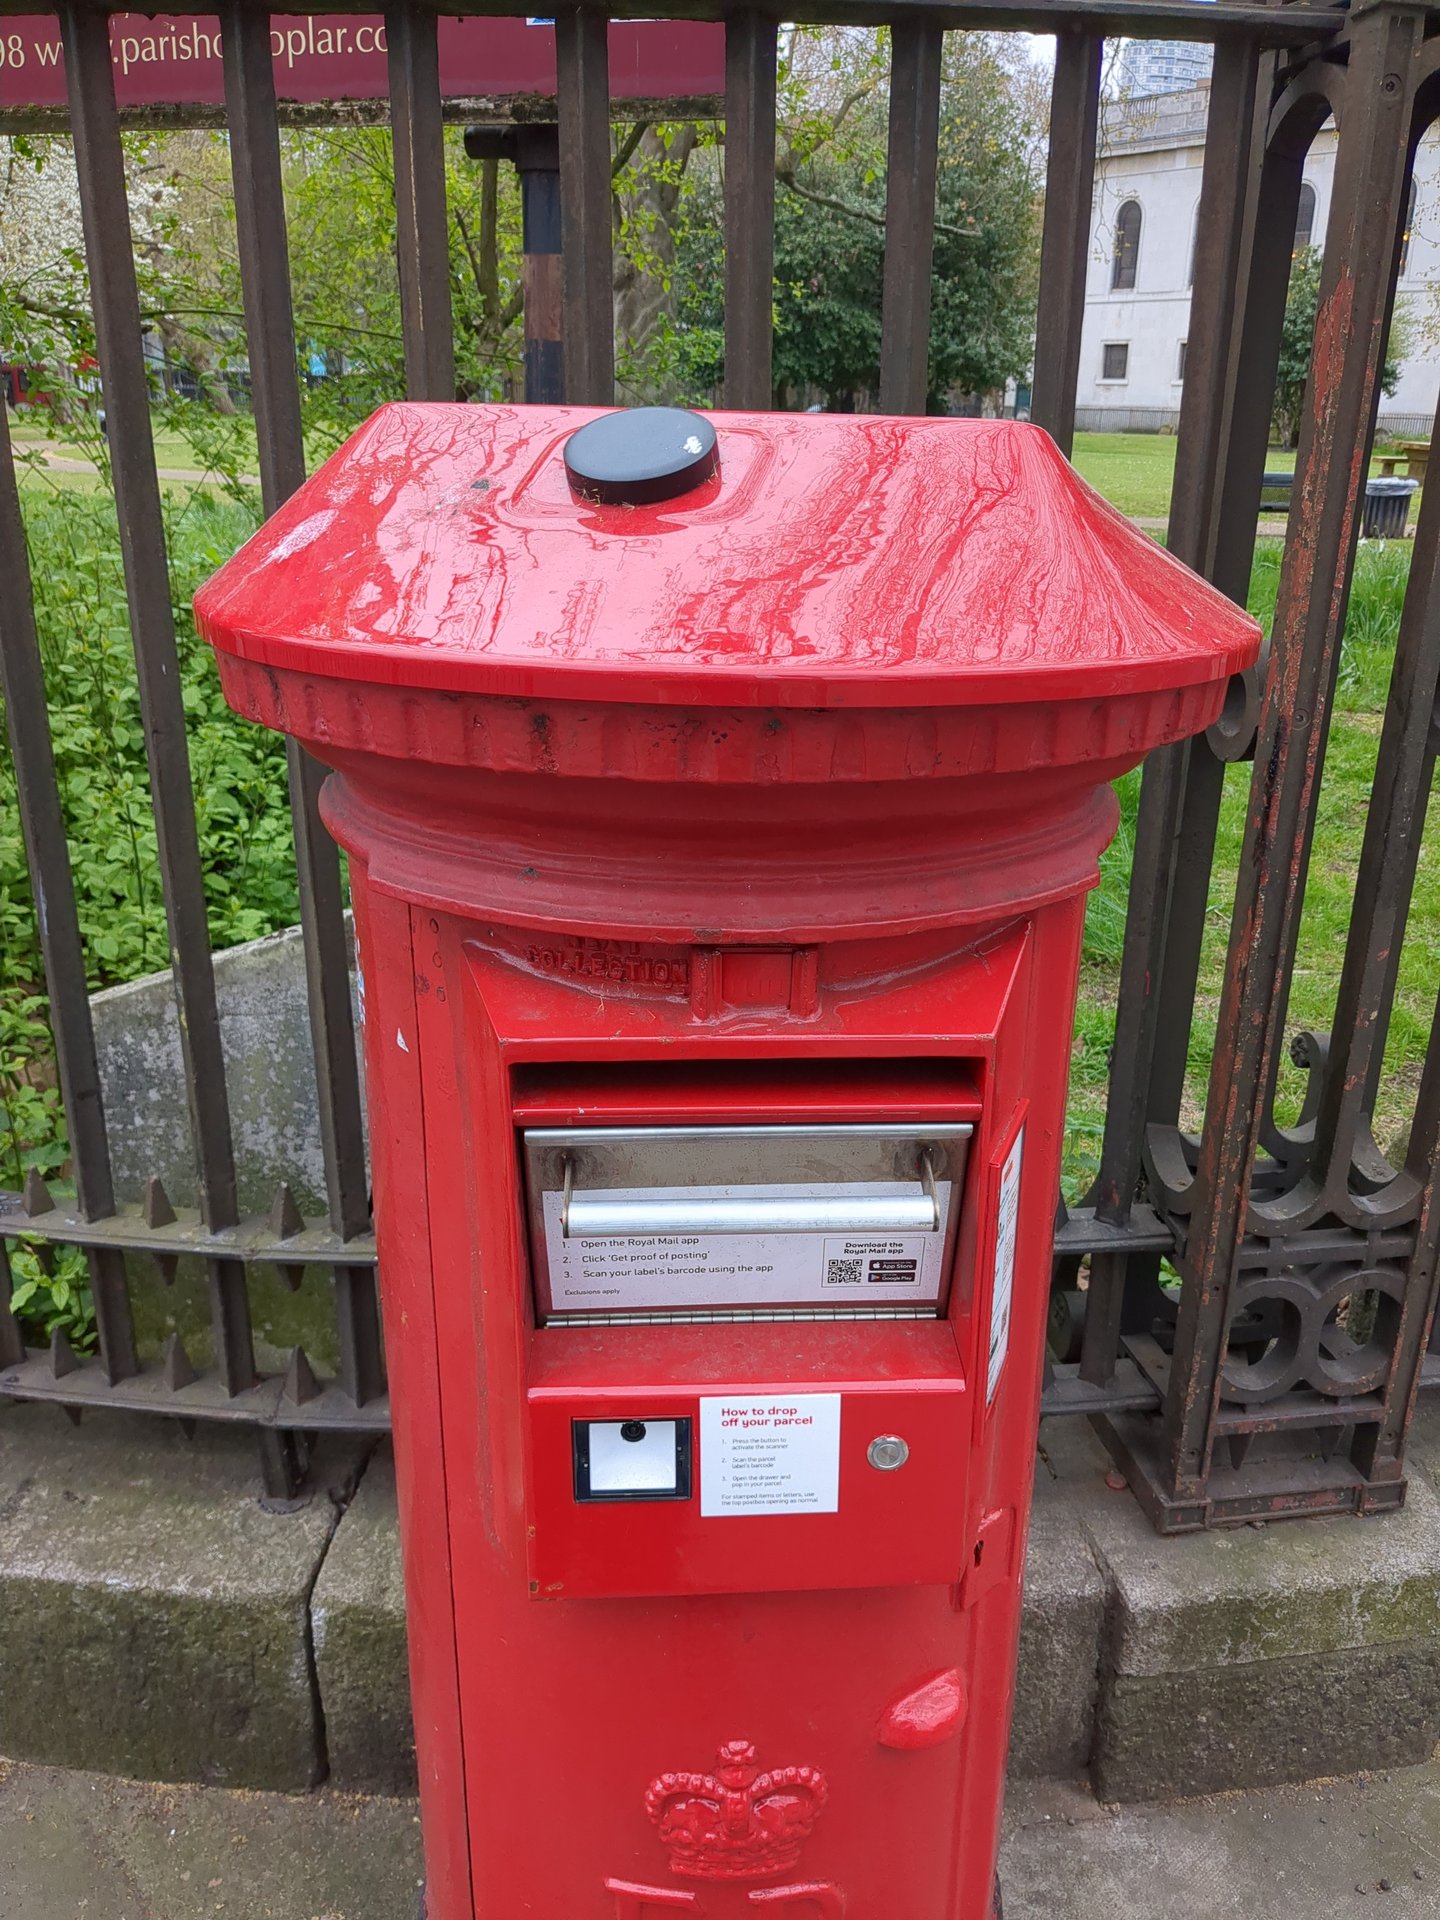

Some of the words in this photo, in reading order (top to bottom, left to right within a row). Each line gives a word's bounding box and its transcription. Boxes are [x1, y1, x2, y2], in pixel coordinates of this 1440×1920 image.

[0, 35, 26, 68] 8
[525, 945, 690, 985] COLLECTION
[580, 1240, 607, 1250] Open
[610, 1239, 626, 1247] the
[628, 1237, 656, 1248] Royal
[658, 1236, 679, 1245] Mail
[582, 1255, 606, 1263] Click
[630, 1252, 657, 1262] proof
[658, 1252, 669, 1260] of
[564, 1270, 573, 1278] 3.
[583, 1270, 607, 1278] Scan
[610, 1270, 632, 1278] your
[634, 1268, 665, 1276] label's
[667, 1266, 706, 1274] barcode
[708, 1266, 735, 1274] using
[721, 1408, 748, 1416] How
[752, 1407, 764, 1416] to
[768, 1406, 798, 1416] drop
[721, 1418, 739, 1427] off
[742, 1418, 770, 1428] your
[774, 1416, 813, 1428] parcel
